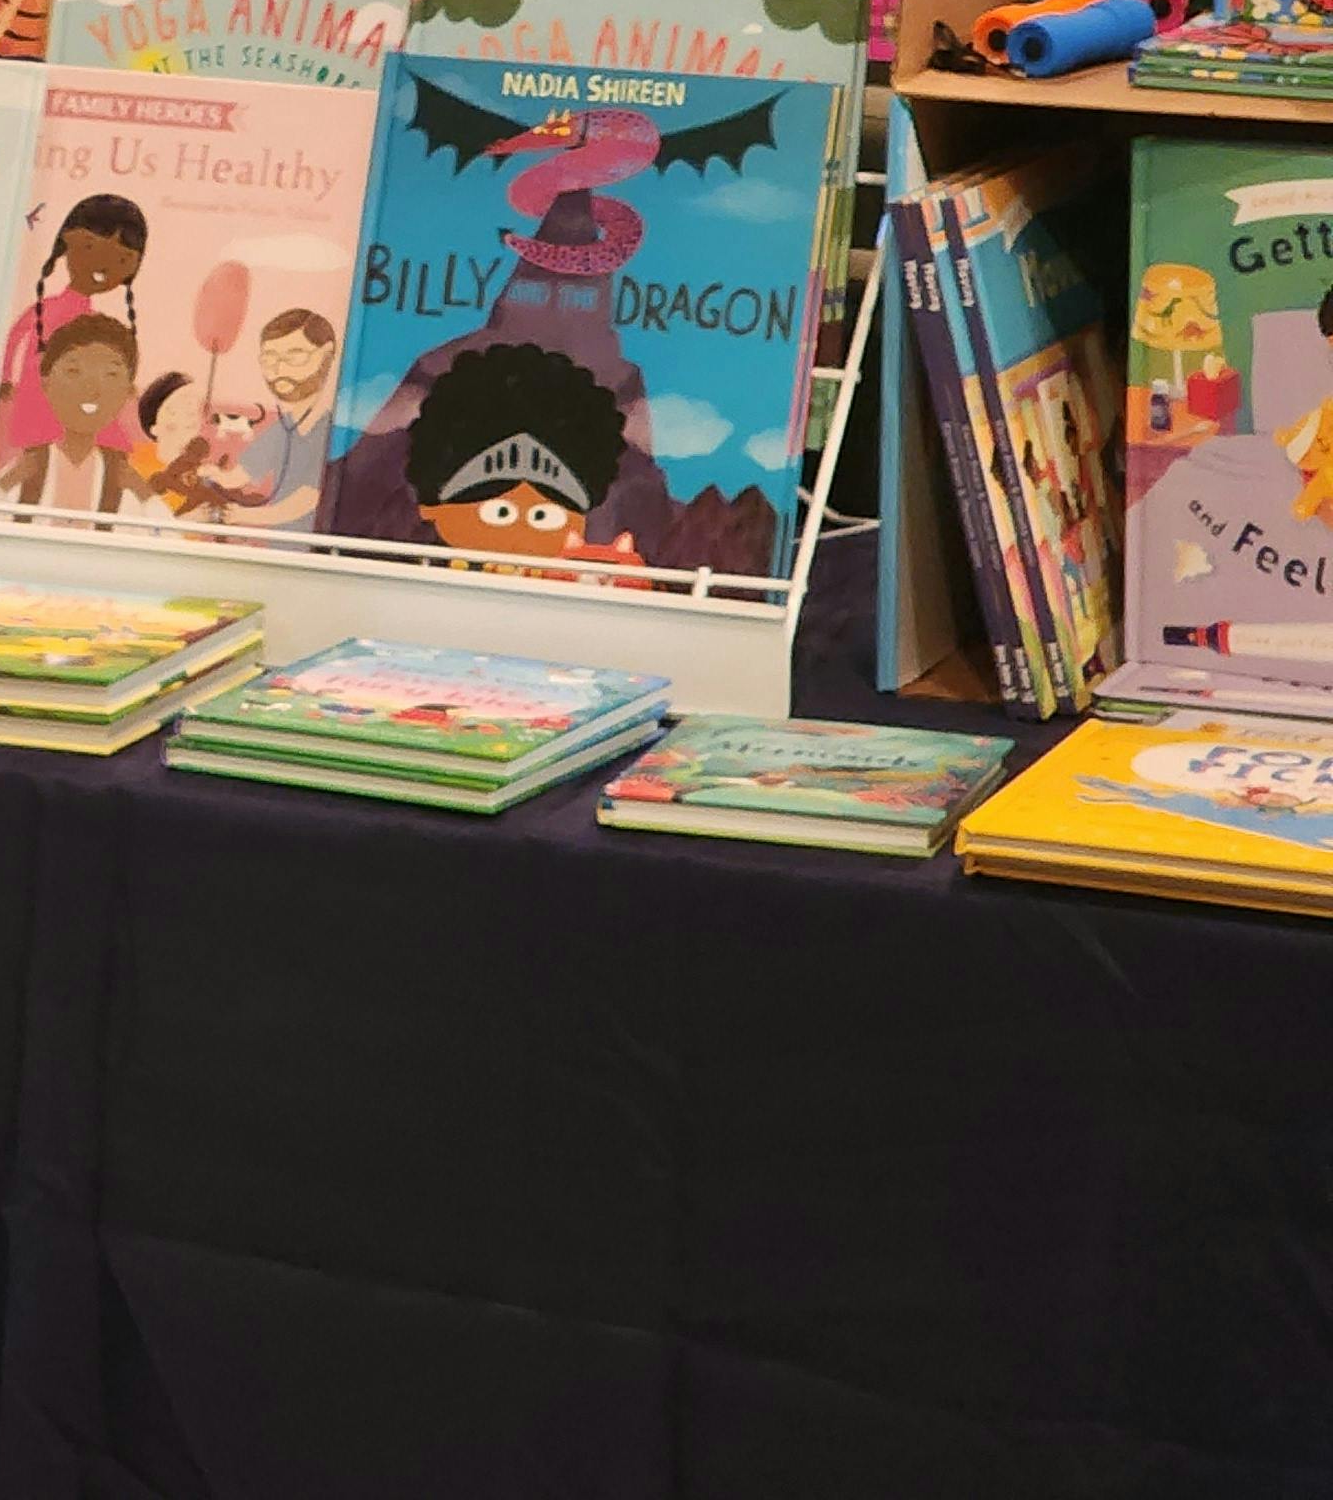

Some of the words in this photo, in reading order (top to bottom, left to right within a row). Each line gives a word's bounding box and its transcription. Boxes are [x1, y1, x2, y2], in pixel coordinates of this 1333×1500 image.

[184, 44, 226, 69] THE
[457, 19, 576, 66] OGA
[50, 92, 136, 118] FAMILY
[138, 98, 222, 127] HEROES
[501, 71, 580, 100] NADIA
[586, 74, 687, 107] SHIREEN
[109, 136, 157, 177] Us
[174, 142, 343, 201] Healthy
[362, 243, 503, 318] BILLY
[613, 276, 798, 343] DRAGON
[1188, 499, 1228, 537] and
[1232, 521, 1327, 595] Feel
